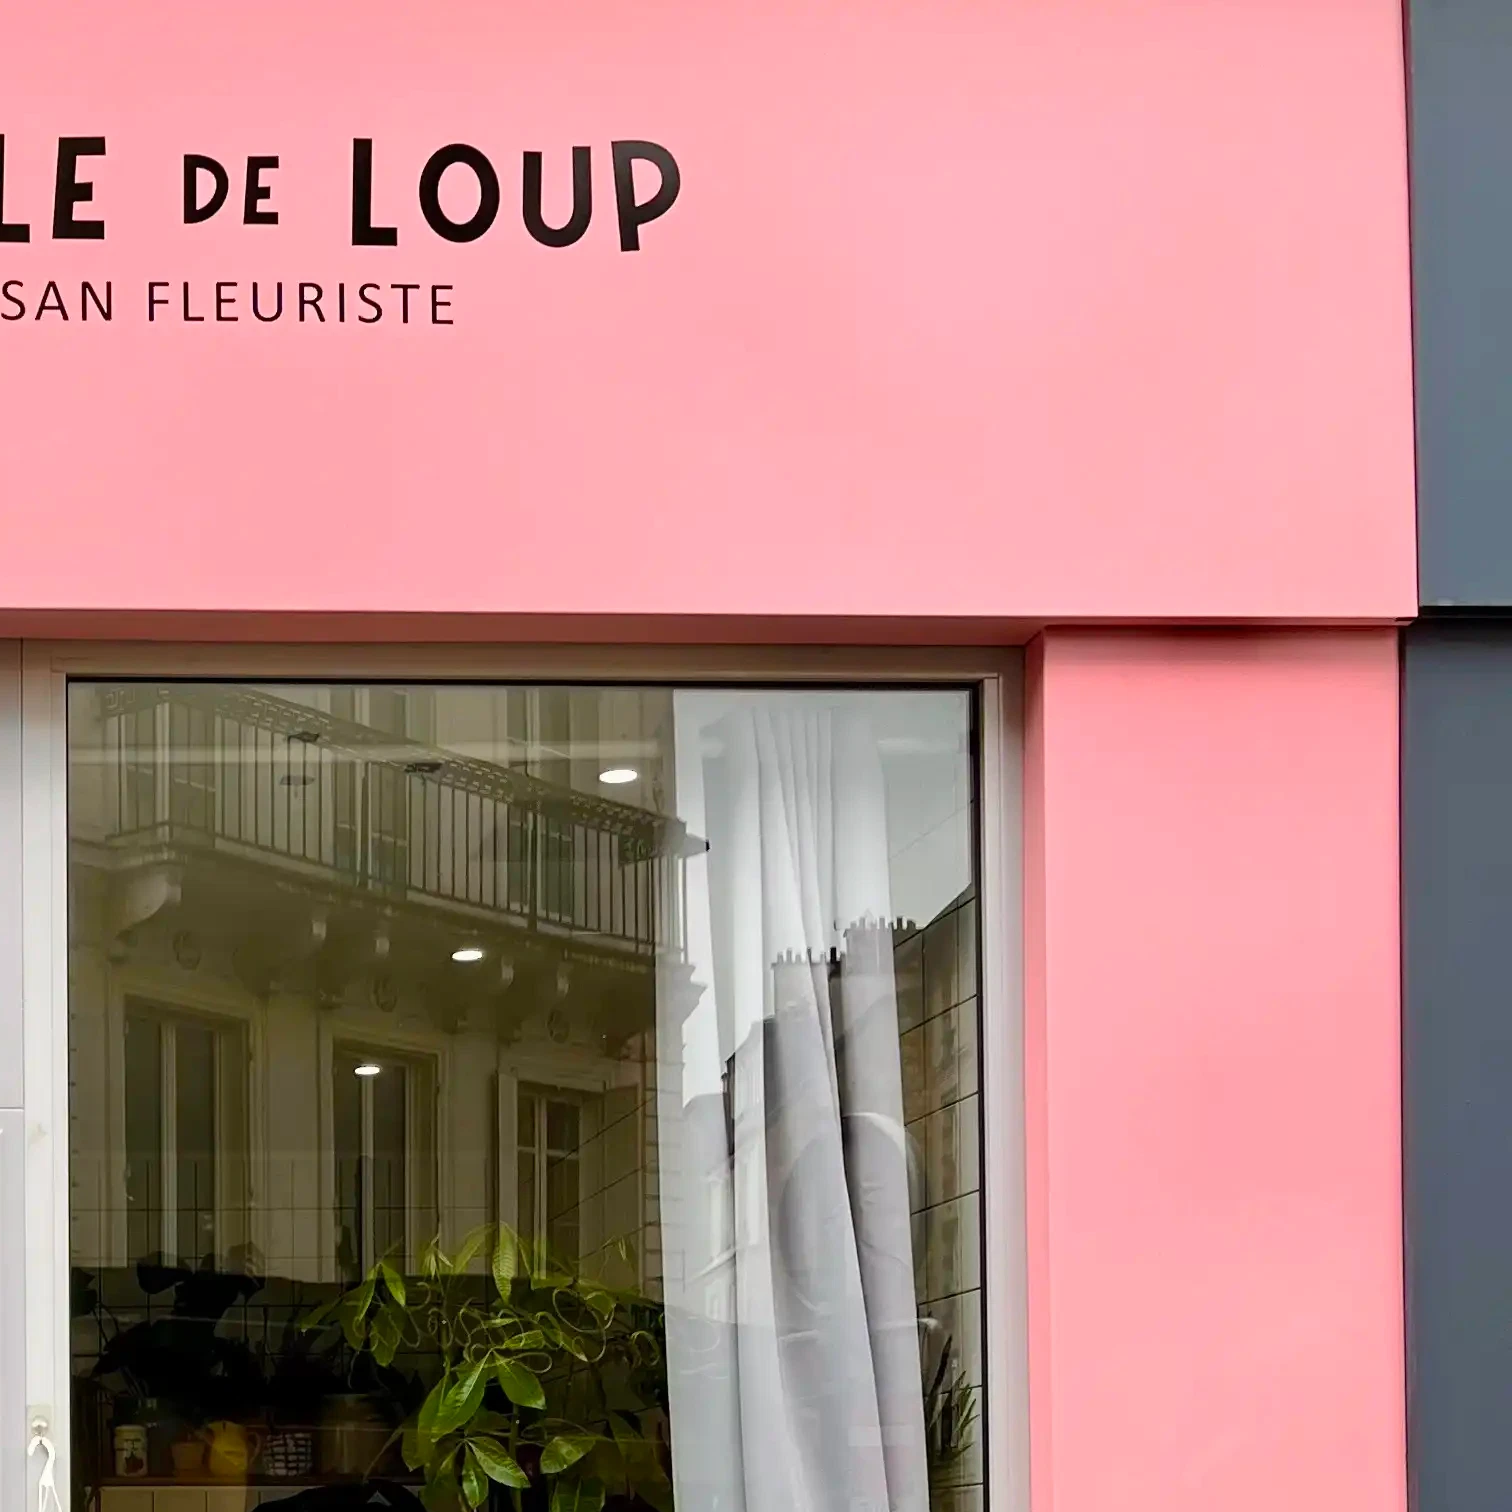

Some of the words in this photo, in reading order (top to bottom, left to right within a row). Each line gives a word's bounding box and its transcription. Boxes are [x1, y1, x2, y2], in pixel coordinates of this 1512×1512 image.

[184, 154, 279, 224] DE
[352, 138, 680, 252] LOUP
[148, 281, 454, 325] FLEURISTE
